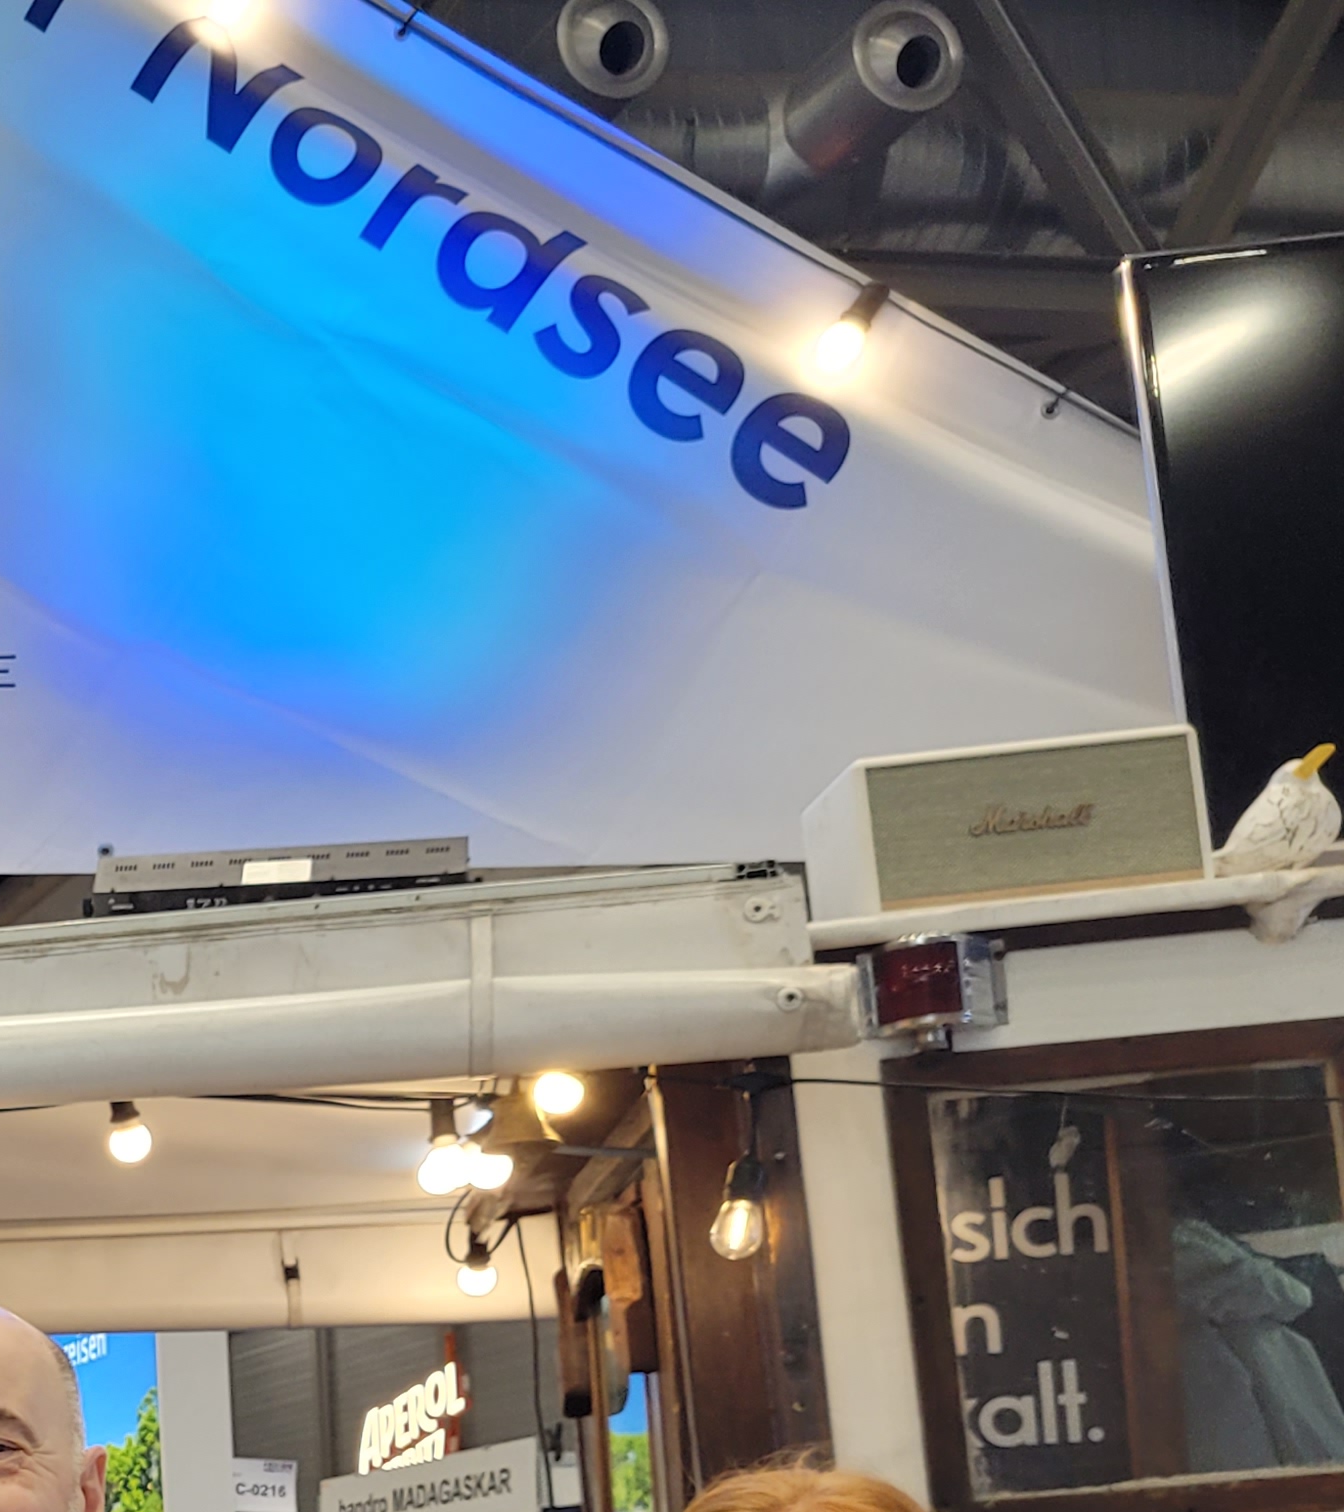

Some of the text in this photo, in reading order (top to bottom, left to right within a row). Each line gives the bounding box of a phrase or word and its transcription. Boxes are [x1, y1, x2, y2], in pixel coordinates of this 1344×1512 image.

[130, 14, 850, 511] Nordsee
[950, 1171, 1109, 1264] sich
[358, 1361, 465, 1475] APEROL
[235, 1482, 287, 1498] C-0216
[392, 1468, 512, 1512] MADAGASKAR
